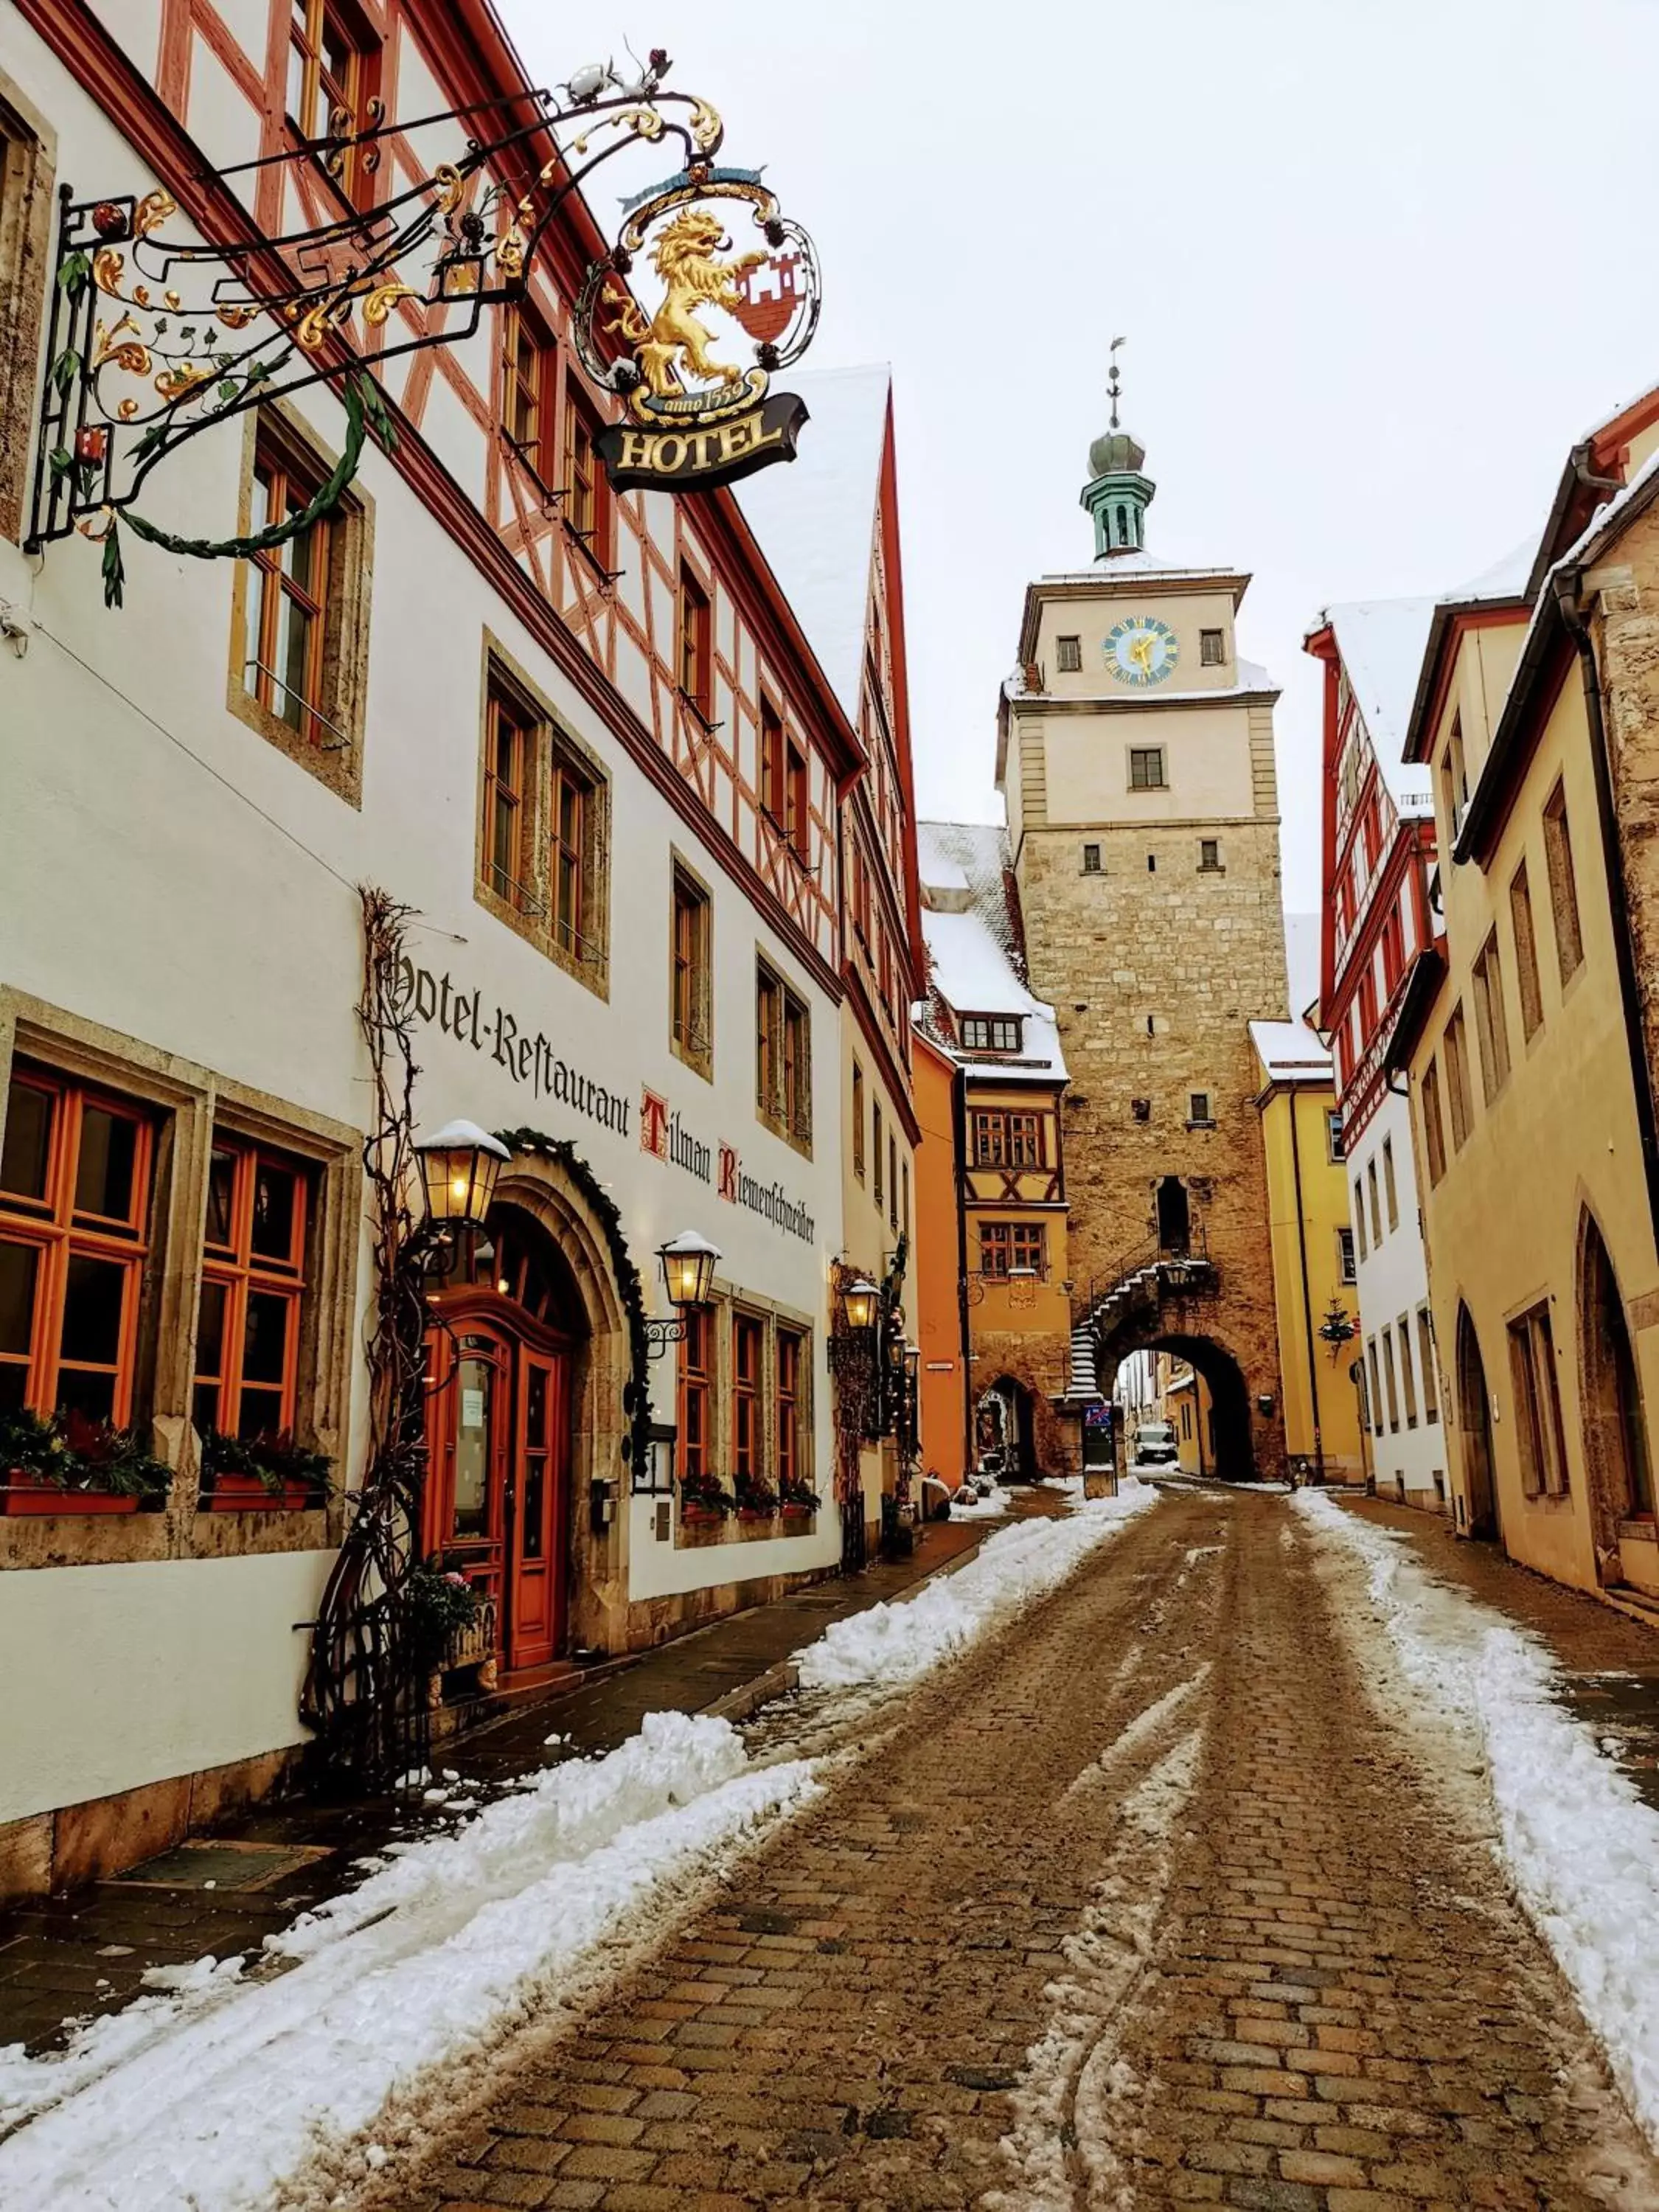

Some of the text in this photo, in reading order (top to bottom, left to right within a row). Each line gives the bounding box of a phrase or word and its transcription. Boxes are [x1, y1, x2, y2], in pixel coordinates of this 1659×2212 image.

[664, 381, 744, 412] anno 1559
[618, 411, 782, 473] HOTEL
[640, 1093, 711, 1184] Tilman
